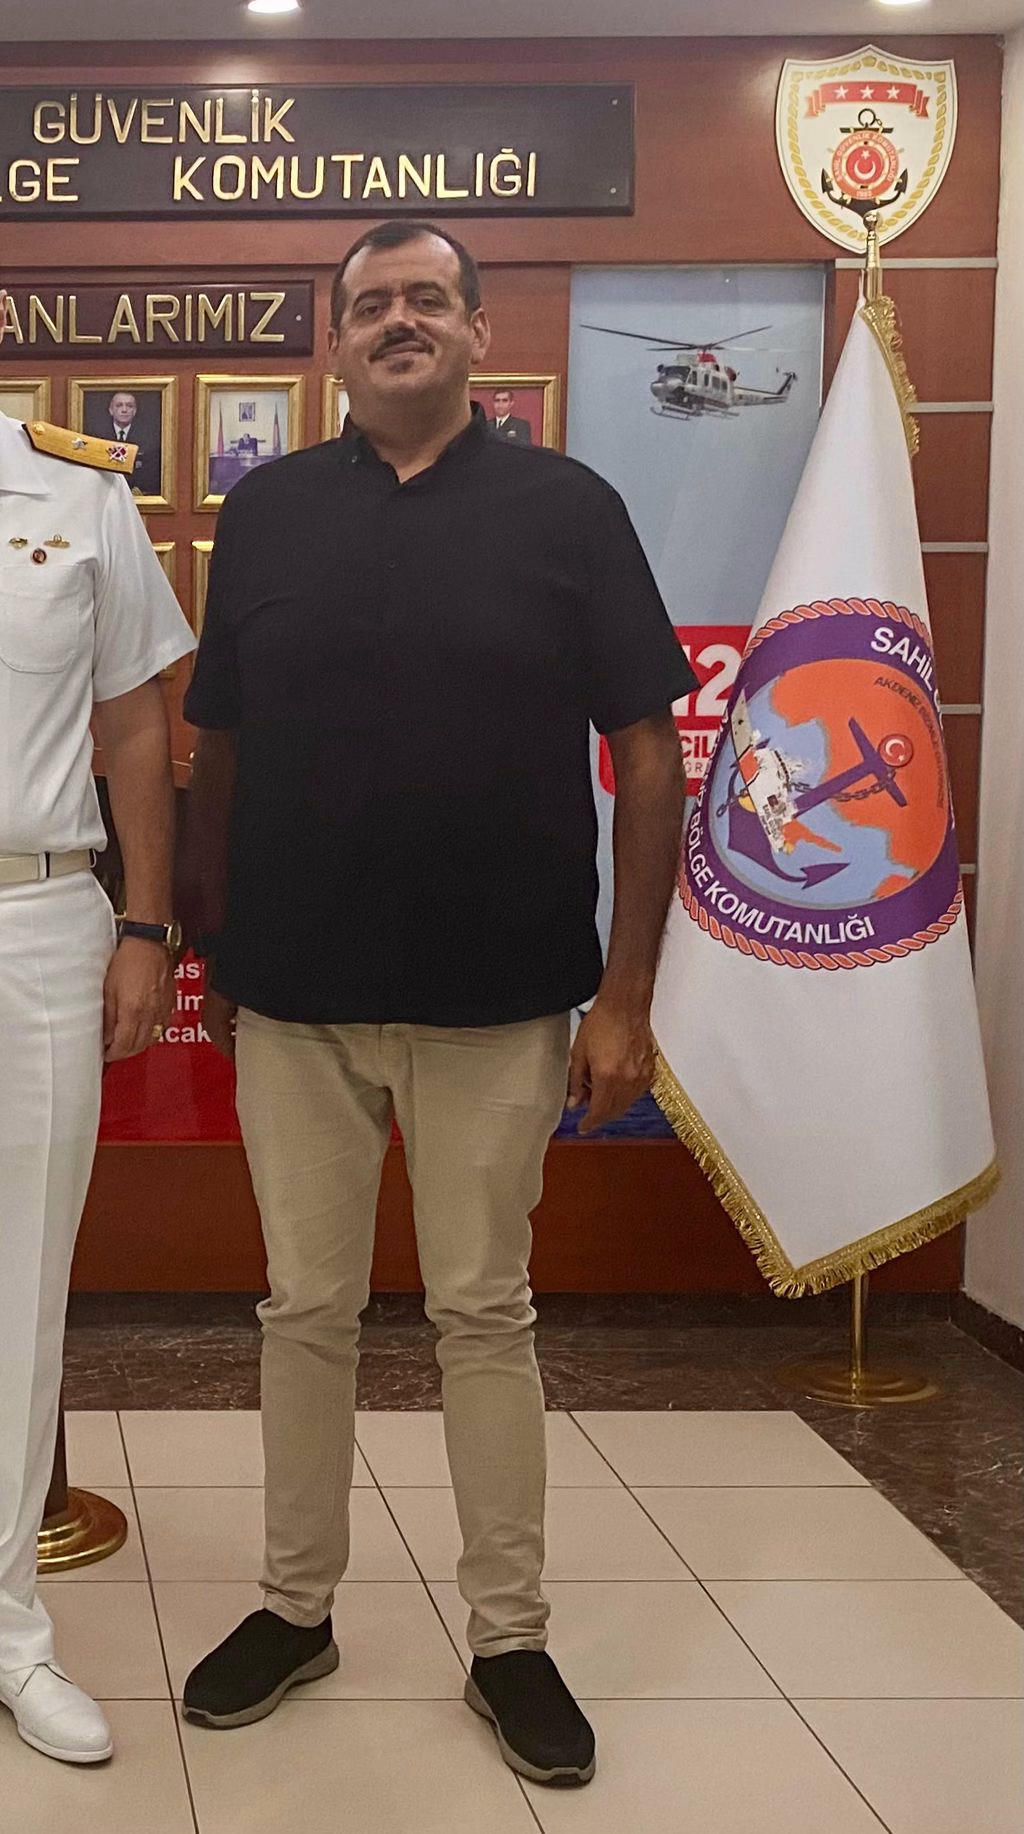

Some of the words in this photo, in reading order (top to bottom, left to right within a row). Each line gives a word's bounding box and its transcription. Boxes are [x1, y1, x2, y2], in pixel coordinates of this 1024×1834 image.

[33, 89, 296, 145] GÜVENLİK
[173, 148, 537, 201] KOMUTANLIĞI
[871, 627, 933, 691] SAHİL
[687, 811, 715, 888] BÖLGE
[704, 880, 875, 945] KOMUTANLIĞI
